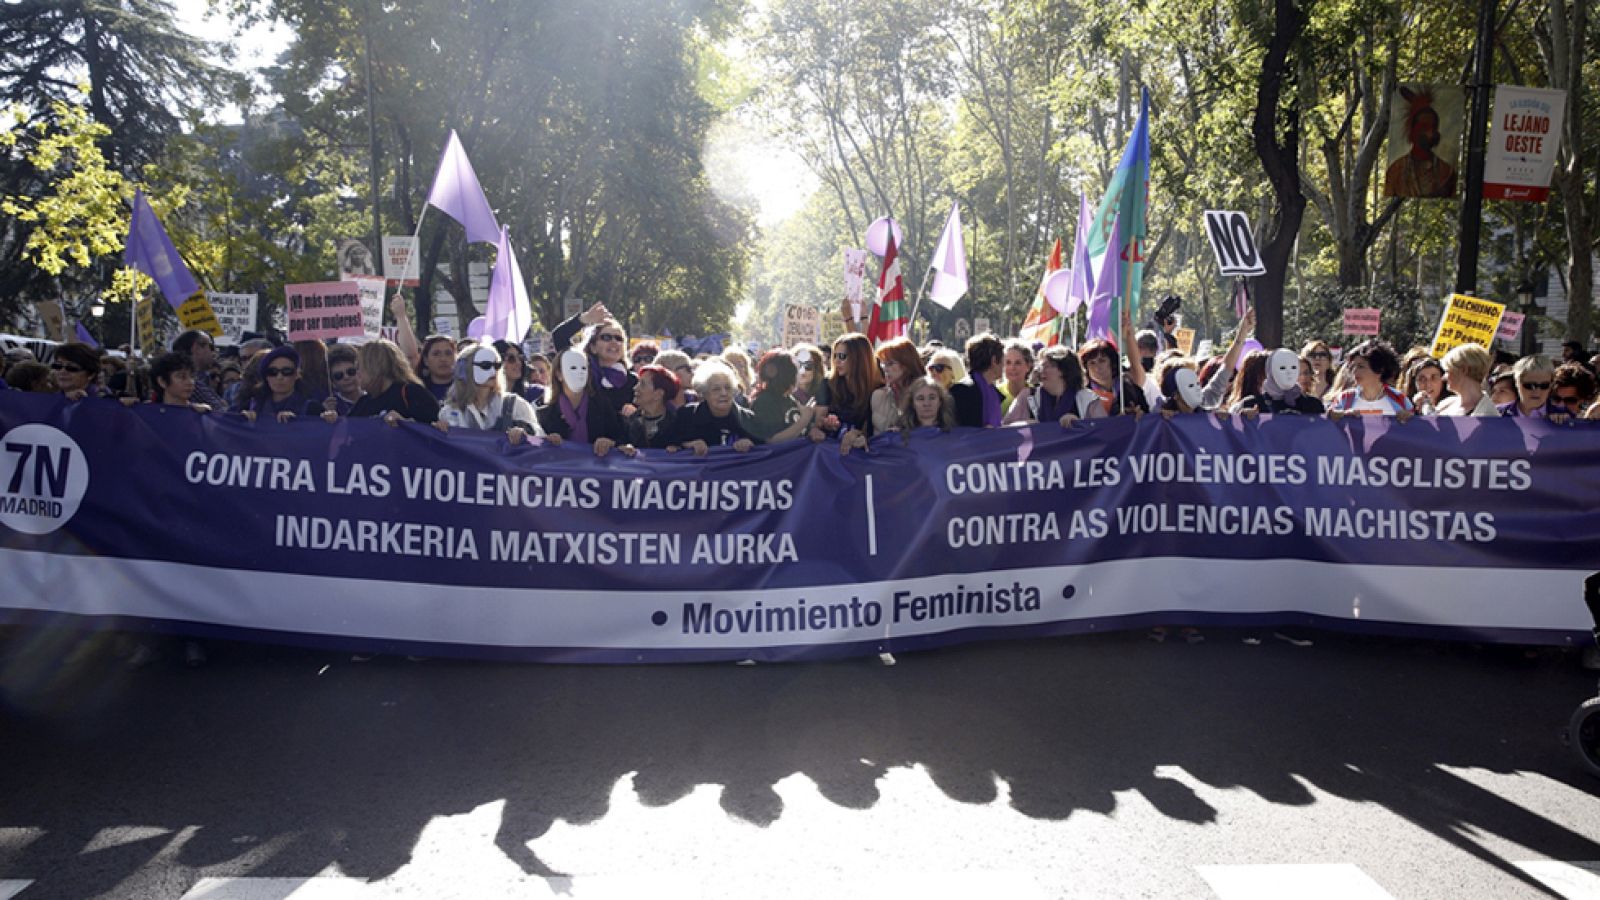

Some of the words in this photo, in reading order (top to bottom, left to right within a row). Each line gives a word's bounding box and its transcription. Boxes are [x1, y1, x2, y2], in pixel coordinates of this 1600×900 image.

[1503, 113, 1551, 135] LEJANO
[1505, 135, 1543, 155] OESTE
[1207, 213, 1258, 268] NO
[290, 318, 305, 333] por
[322, 312, 362, 330] mujeres!
[305, 293, 323, 309] más
[324, 293, 360, 308] muertes
[5, 442, 71, 499] 7N
[185, 450, 316, 493] CONTRA
[327, 461, 391, 498] LAS
[401, 467, 600, 509] VIOLENCIAS
[611, 479, 793, 511] MACHISTAS
[946, 458, 1065, 495] CONTRA
[1073, 453, 1121, 488] LES
[1129, 448, 1307, 485] VIOLÈNCIES
[1317, 456, 1532, 491] MASCLISTES
[0, 496, 63, 519] MADRID
[947, 510, 1061, 548] CONTRA
[1068, 508, 1109, 540] AS
[1117, 503, 1294, 535] VIOLENCIAS
[1304, 506, 1497, 542] MACHISTAS
[275, 515, 480, 561] INDARKERIA
[490, 530, 681, 565] MATXISTEN
[691, 533, 799, 565] AURKA
[681, 596, 882, 635] Movimiento
[893, 581, 1041, 624] Feminista
